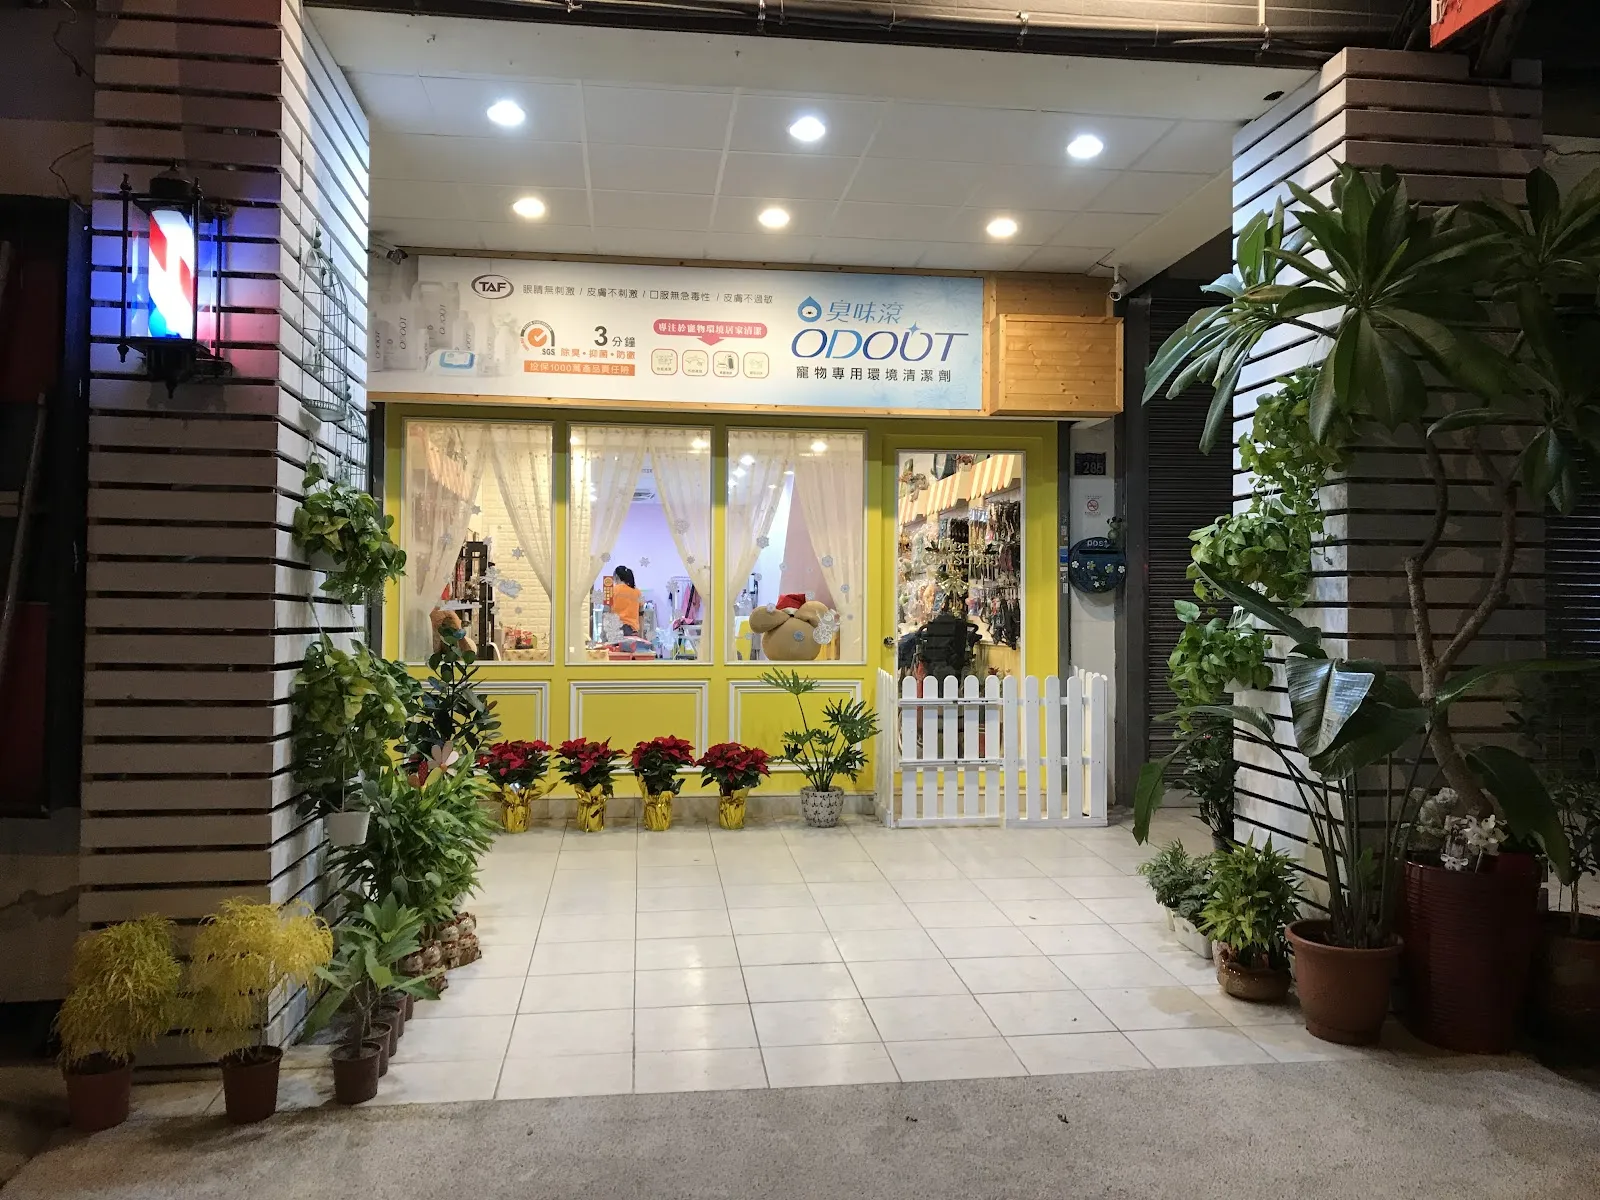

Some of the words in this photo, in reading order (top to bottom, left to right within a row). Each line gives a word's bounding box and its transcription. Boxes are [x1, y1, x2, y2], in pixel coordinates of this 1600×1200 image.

[479, 281, 506, 293] TAF
[522, 284, 575, 296] 眼睛無刺激
[586, 287, 638, 299] 皮膚不刺激
[649, 290, 710, 302] 口服無急毒性
[723, 293, 773, 304] 皮膚不過敏
[594, 325, 608, 347] 3
[611, 336, 636, 348] 分鐘
[791, 326, 969, 362] ODOUT
[541, 348, 556, 356] SGS
[796, 365, 951, 383] 寵物專用環境清潔劑
[1083, 461, 1104, 475] 285
